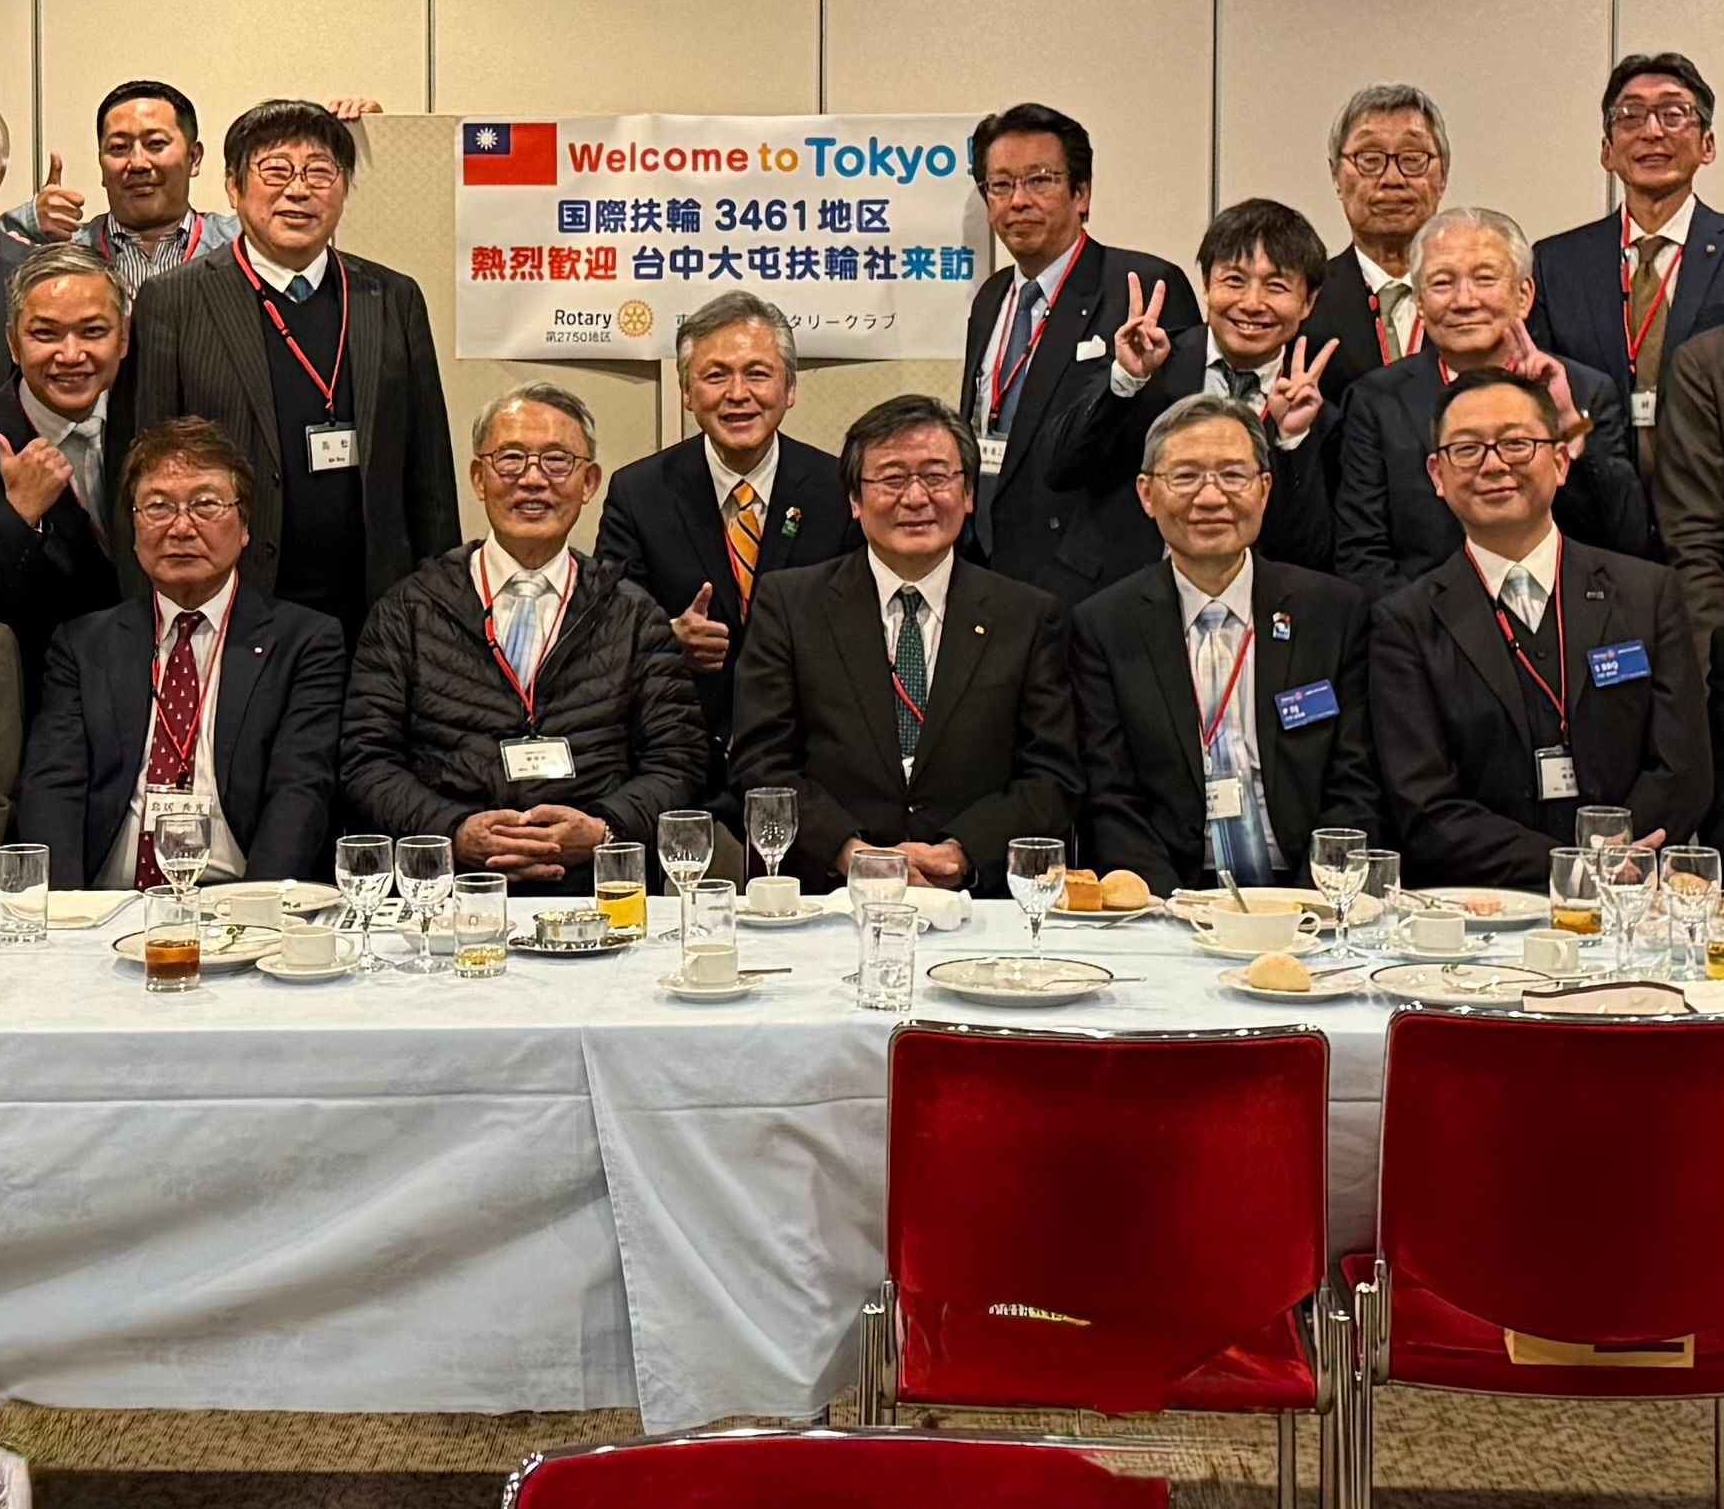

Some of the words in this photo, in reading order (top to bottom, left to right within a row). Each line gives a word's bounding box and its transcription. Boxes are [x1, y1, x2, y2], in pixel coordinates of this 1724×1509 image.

[568, 141, 749, 173] Welcome
[758, 142, 799, 172] to
[804, 136, 957, 184] Tokyo
[558, 198, 702, 234] 国際扶輪
[554, 309, 612, 329] Rotary
